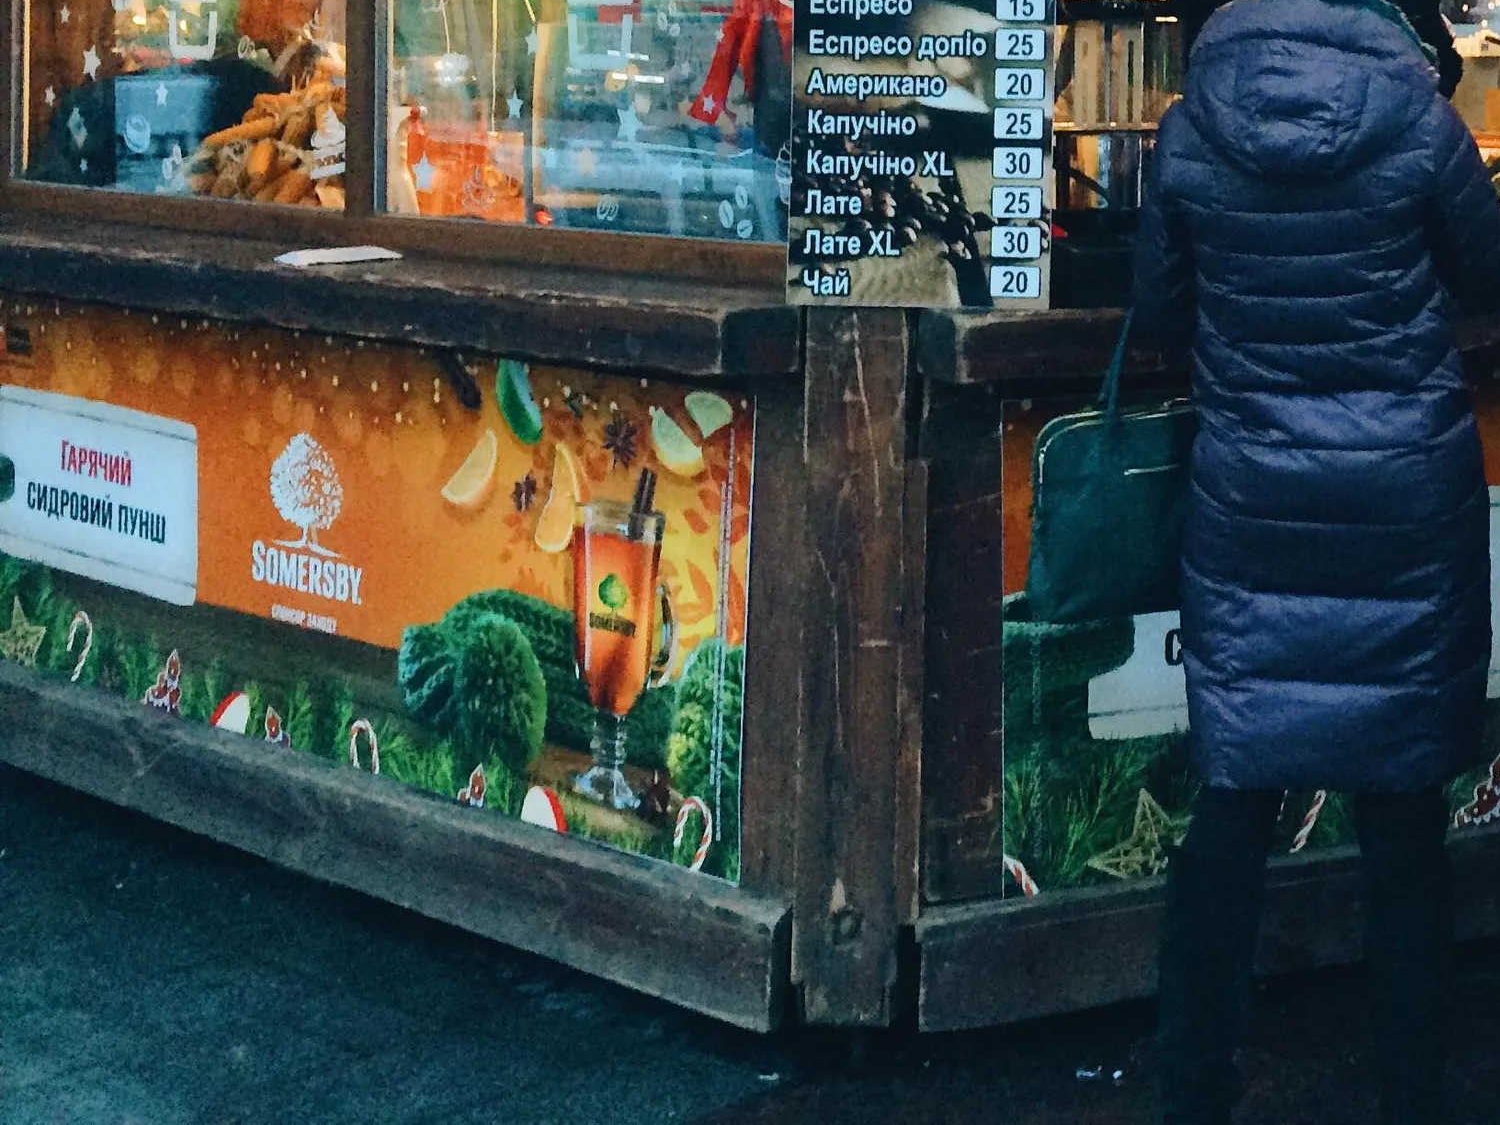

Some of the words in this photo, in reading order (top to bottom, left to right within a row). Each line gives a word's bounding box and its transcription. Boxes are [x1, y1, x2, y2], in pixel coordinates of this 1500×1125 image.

[808, 29, 912, 61] Еспресо
[1006, 33, 1034, 56] 25
[806, 69, 945, 100] Американо
[1006, 73, 1032, 96] 20
[807, 109, 917, 141] Капучіно
[1005, 112, 1032, 135] 25
[806, 149, 916, 181] Капучіно
[922, 151, 954, 177] XL
[1004, 152, 1031, 175] 30
[804, 189, 862, 216] Лате
[1003, 191, 1031, 214] 25
[803, 228, 861, 255] Лате
[868, 230, 900, 256] XL
[1002, 231, 1029, 254] 30
[803, 269, 849, 295] Чай
[1001, 271, 1028, 293] 20
[61, 439, 132, 487] ГАРЯЧИЙ
[27, 481, 113, 530] СИДРОВИЙ
[118, 503, 166, 545] ПУНШ
